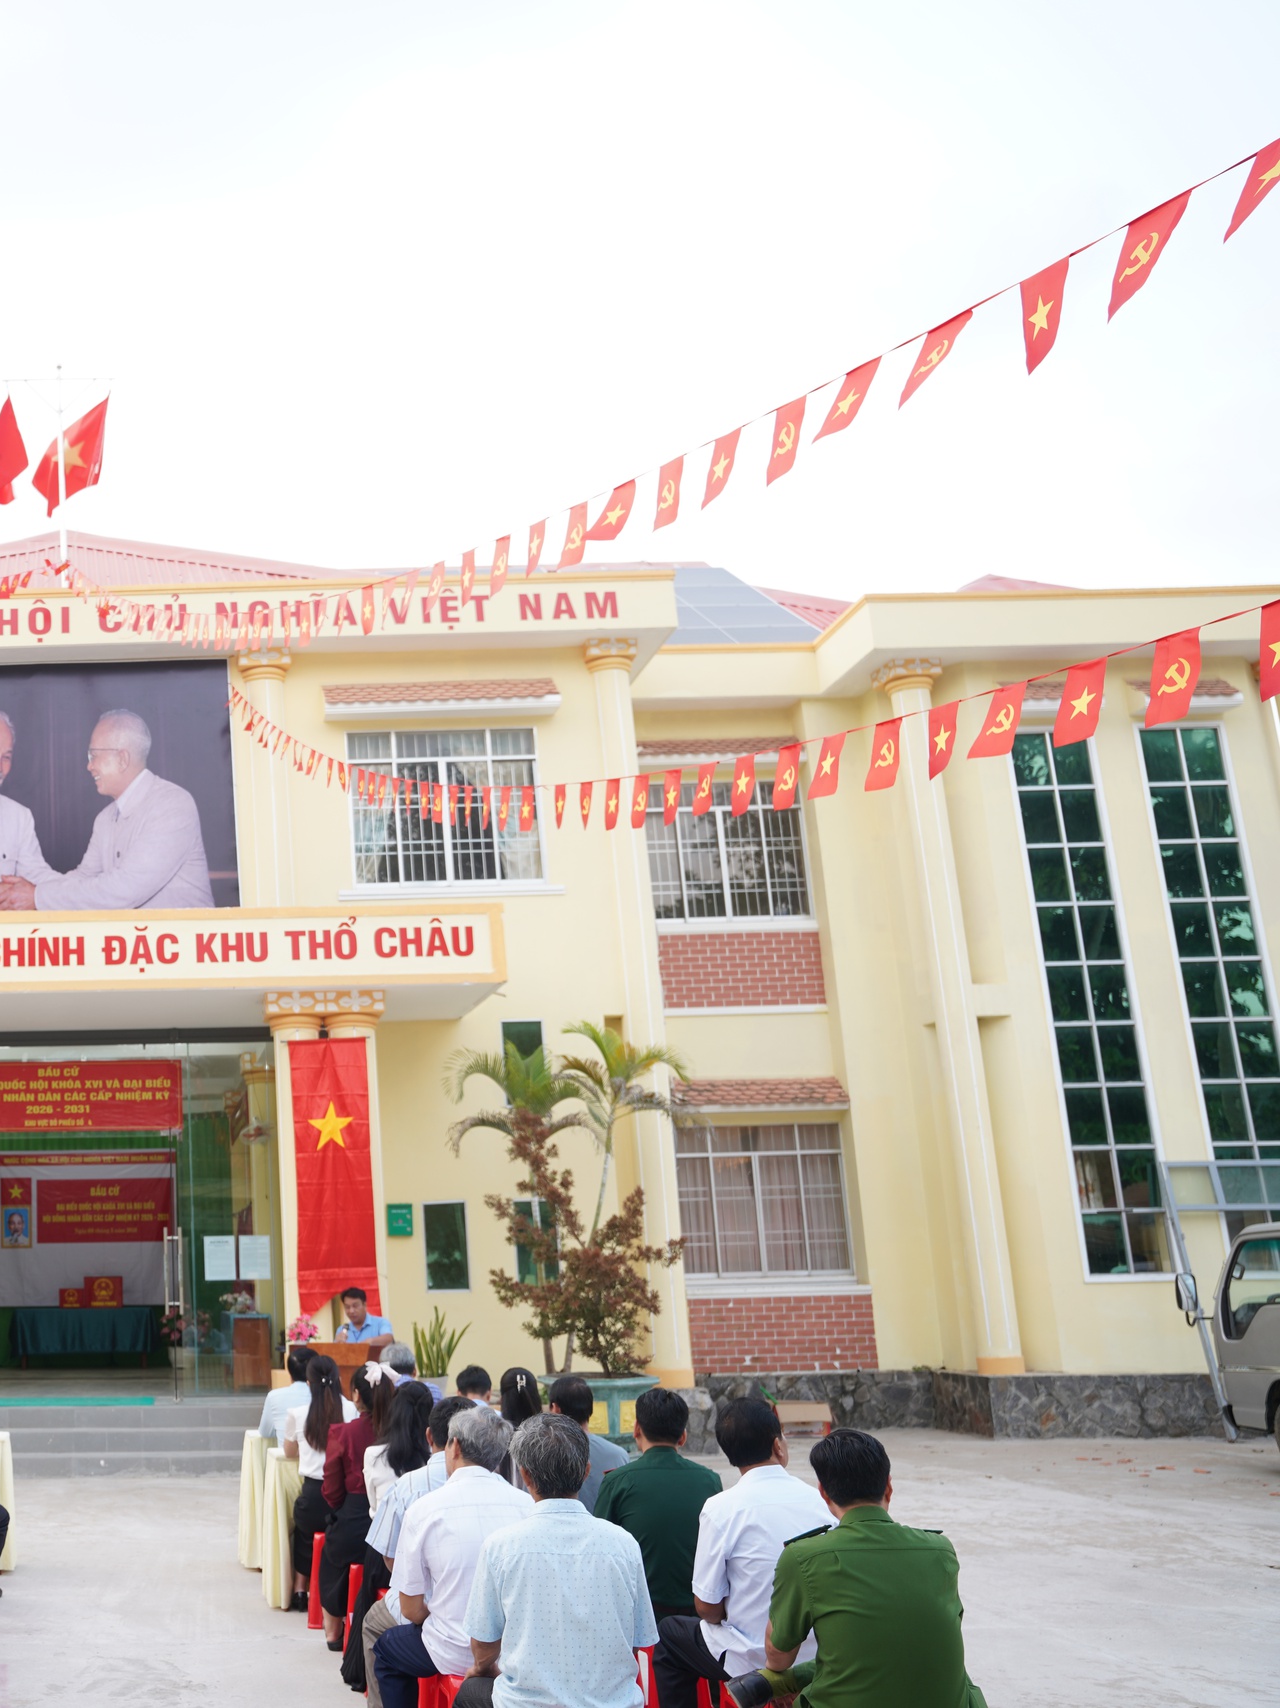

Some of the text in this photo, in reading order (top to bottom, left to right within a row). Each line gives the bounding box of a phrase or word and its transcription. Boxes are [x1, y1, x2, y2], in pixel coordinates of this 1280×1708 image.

[389, 588, 489, 630] VIỆT
[518, 591, 619, 620] NAM
[101, 925, 179, 974] ĐẶC
[195, 931, 269, 964] KHU
[284, 916, 358, 960] THỔ
[373, 917, 475, 958] CHÂU
[29, 1079, 49, 1091] HỘI
[84, 1079, 103, 1089] XVI
[105, 1077, 121, 1089] VÀ
[123, 1079, 142, 1090] ĐẠI
[3, 1091, 35, 1102] NHÂN
[37, 1091, 61, 1102] DÂN
[63, 1090, 87, 1101] CÁC
[89, 1089, 112, 1101] CẤP
[115, 1089, 153, 1103] NHIỆM
[25, 1105, 54, 1115] 2026
[63, 1104, 91, 1114] 2031
